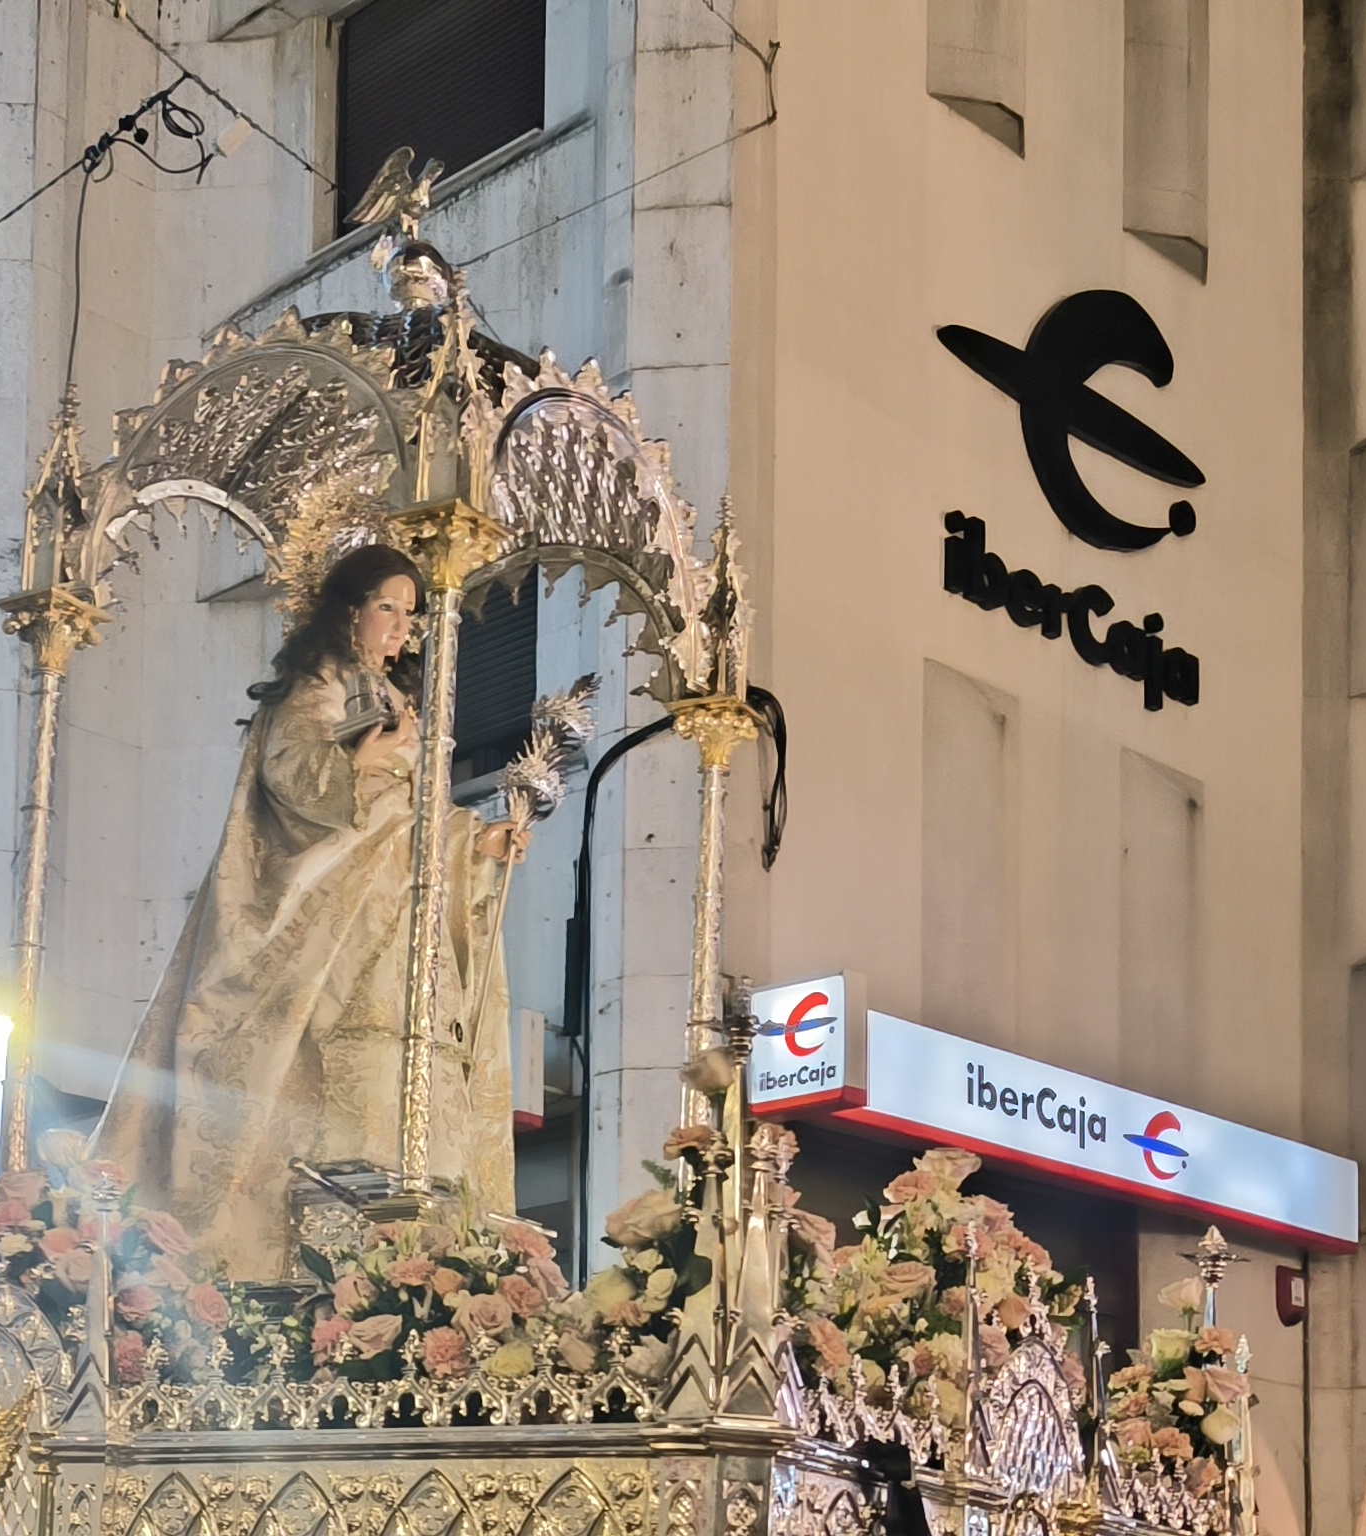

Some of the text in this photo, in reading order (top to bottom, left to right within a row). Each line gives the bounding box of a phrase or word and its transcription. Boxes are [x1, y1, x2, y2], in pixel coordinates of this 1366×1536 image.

[942, 510, 1200, 712] iberCaja
[759, 1061, 837, 1092] iberCaja
[966, 1062, 1107, 1150] iberCaja
